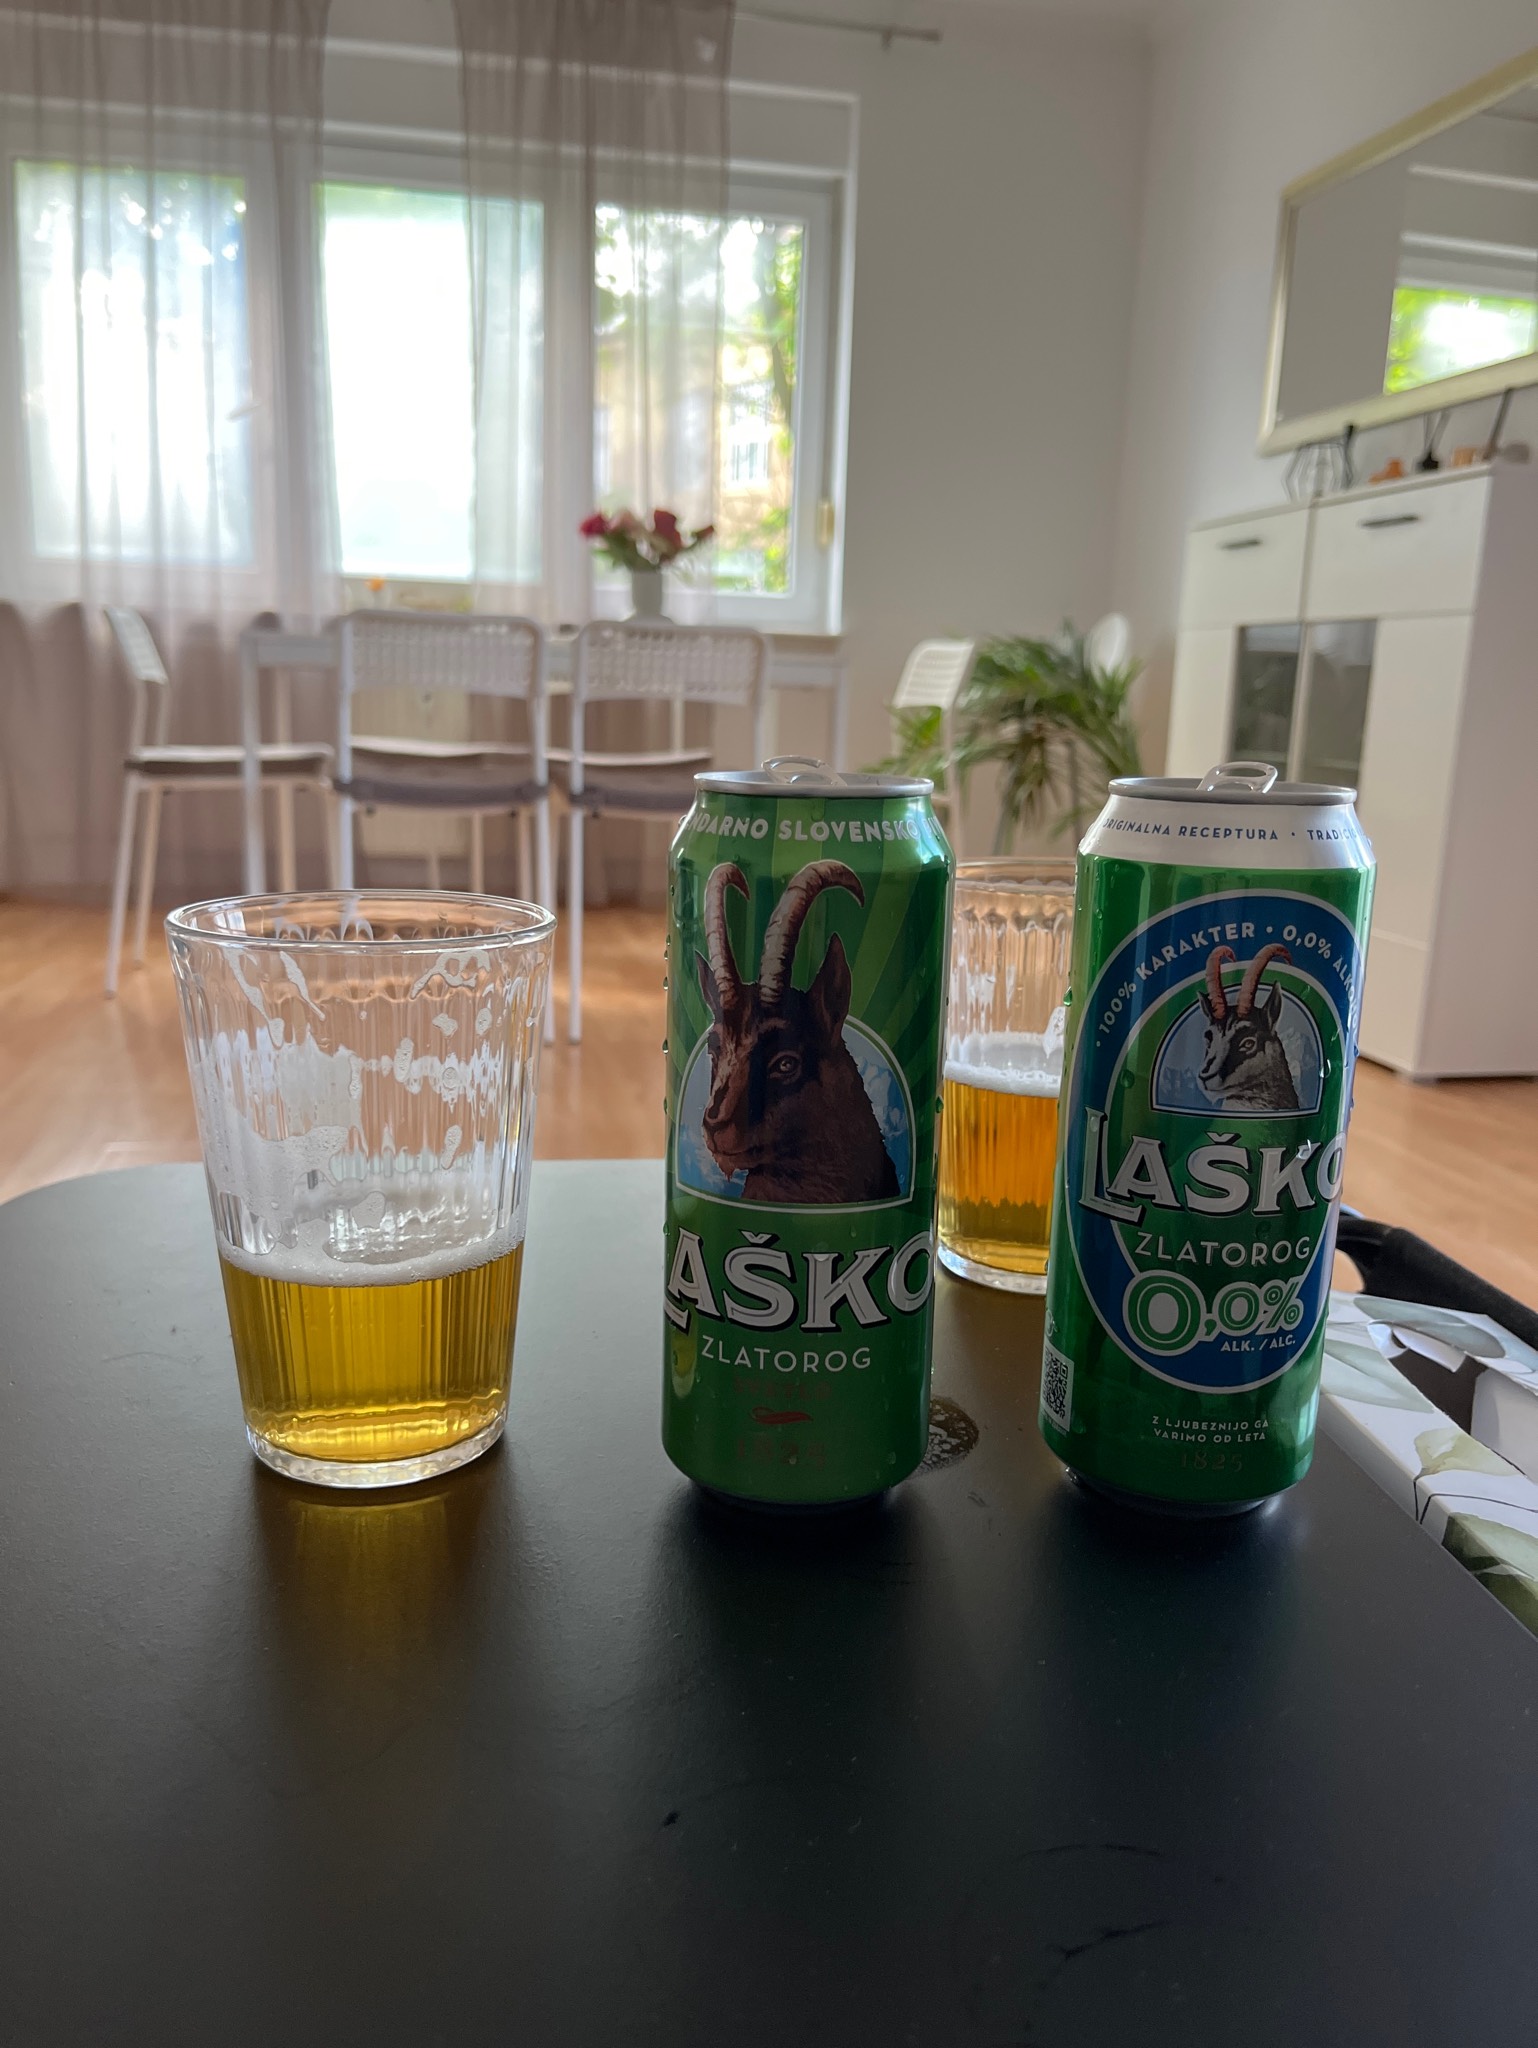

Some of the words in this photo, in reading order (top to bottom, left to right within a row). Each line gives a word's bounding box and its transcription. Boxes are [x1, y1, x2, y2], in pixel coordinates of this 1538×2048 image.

[686, 812, 769, 840] NDARNO
[778, 819, 921, 843] SLOVENSKO
[1178, 826, 1279, 841] RECEPTURA
[1098, 981, 1138, 1035] 100%
[1136, 922, 1256, 981] KARAKTER
[1282, 924, 1332, 960] 0,0%
[1078, 1106, 1347, 1227] LAŠKO
[1134, 1230, 1311, 1267] ZLATOROG
[664, 1227, 936, 1334] AŠKO
[1122, 1269, 1305, 1357] 0,0%
[701, 1334, 872, 1373] ZLATOROG
[1220, 1339, 1255, 1352] ALK.
[1152, 1415, 1160, 1425] Z
[1165, 1417, 1250, 1431] LJUBEZNIJO
[1254, 1418, 1270, 1429] GA
[1153, 1428, 1207, 1444] VARIMO
[1213, 1434, 1233, 1444] OD
[1237, 1432, 1266, 1443] LETA
